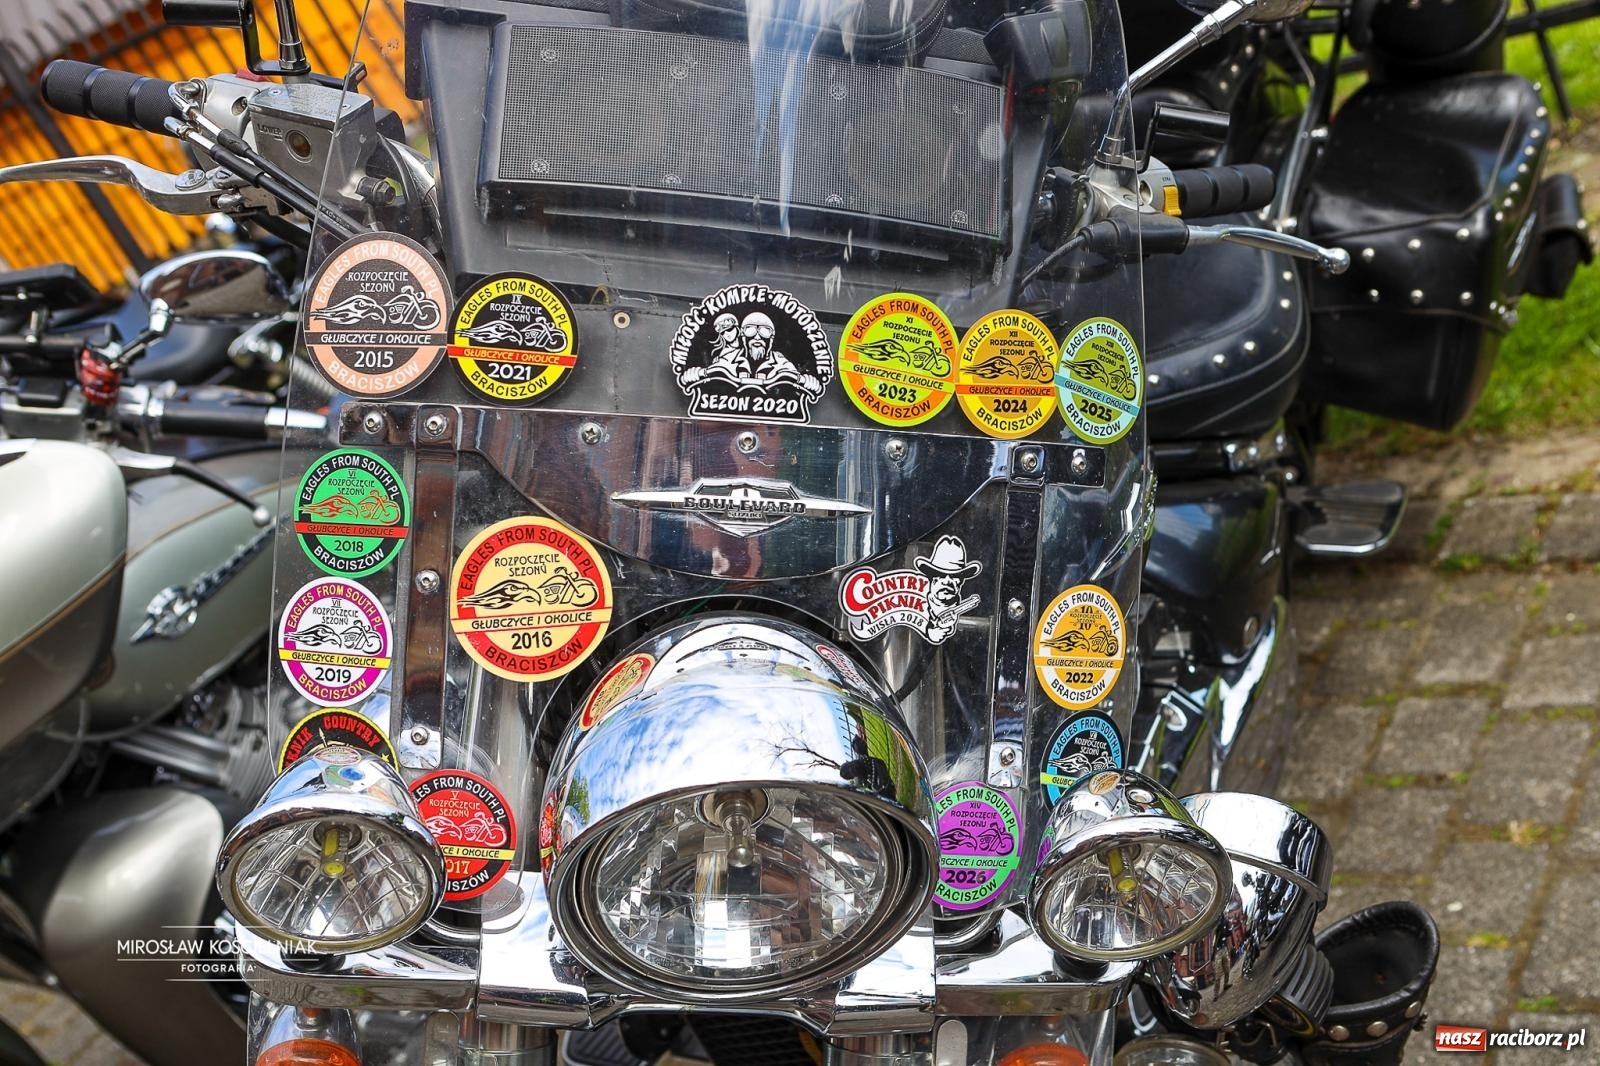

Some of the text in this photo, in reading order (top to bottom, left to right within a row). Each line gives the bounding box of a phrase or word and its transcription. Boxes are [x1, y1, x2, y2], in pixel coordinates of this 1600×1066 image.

[316, 243, 439, 303] EAGLES FROM SOUTH PL
[460, 281, 568, 328] EAGLES FROM SOUTH PL
[705, 286, 767, 316] KUMPLE
[852, 300, 953, 354] EAGLES FROM SOUTH PL
[386, 334, 431, 344] OKOLICE
[963, 316, 1055, 361] EAGLES FROM SOUTH PL
[354, 350, 394, 368] 2015
[521, 353, 560, 364] OKOLICE
[1066, 323, 1139, 379] EAGLES FROM SOUTH PL
[328, 361, 420, 391] BRACISZÓW
[488, 363, 531, 380] 2021
[470, 370, 548, 397] BRACISZÓW
[878, 383, 917, 403] 2023
[908, 376, 943, 390] OKOLICE
[1020, 387, 1051, 396] OKOLICE
[700, 393, 798, 414] SEZON 2020
[857, 387, 931, 418] BRACISZÓW
[993, 398, 1027, 413] 2024
[1080, 399, 1112, 422] 2025
[1106, 396, 1131, 412] OKOLICE
[976, 407, 1043, 431] BRACISZÓW
[1066, 403, 1121, 436] BRACISZÓW
[302, 455, 400, 500] EAGLES FROM SOUTH PL
[683, 497, 806, 514] BOULEVARD
[358, 527, 394, 536] OKOLICE
[334, 539, 364, 552] 2018
[313, 545, 384, 570] BRACISZÓW
[460, 528, 594, 591] EAGLES FROM SOUTH PL
[845, 572, 929, 612] COUNTRY
[288, 584, 383, 630] EAGLES FROM SOUTH PL
[868, 594, 927, 620] PIKNIK
[1043, 592, 1120, 635] EAGLES FROM SOUTH PL
[544, 612, 592, 625] OKOLICE
[900, 612, 924, 627] 2018
[511, 631, 552, 650] 2016
[341, 656, 376, 666] OKOLICE
[484, 638, 583, 671] BRACISZÓW
[315, 667, 351, 683] 2019
[1065, 672, 1094, 683] 2022
[298, 674, 367, 699] BRACISZÓW
[1051, 678, 1106, 701] BRACISZÓW
[285, 726, 313, 767] KNIK
[323, 715, 381, 748] COUNTRY
[1053, 718, 1120, 761] EAGLES FROM SOUTH PL
[1052, 776, 1073, 787] GŁUBC
[416, 777, 507, 823] LES FROM SOUTH PL
[937, 788, 1017, 832] LES FROM SOUTH PL
[462, 848, 499, 858] OKOLICE
[941, 857, 969, 866] BCZYCE
[976, 859, 1008, 867] OKOLICE
[446, 859, 470, 875] 017
[945, 870, 986, 884] 2026
[448, 869, 490, 891] ISZÓW
[935, 879, 997, 901] RACISZÓW
